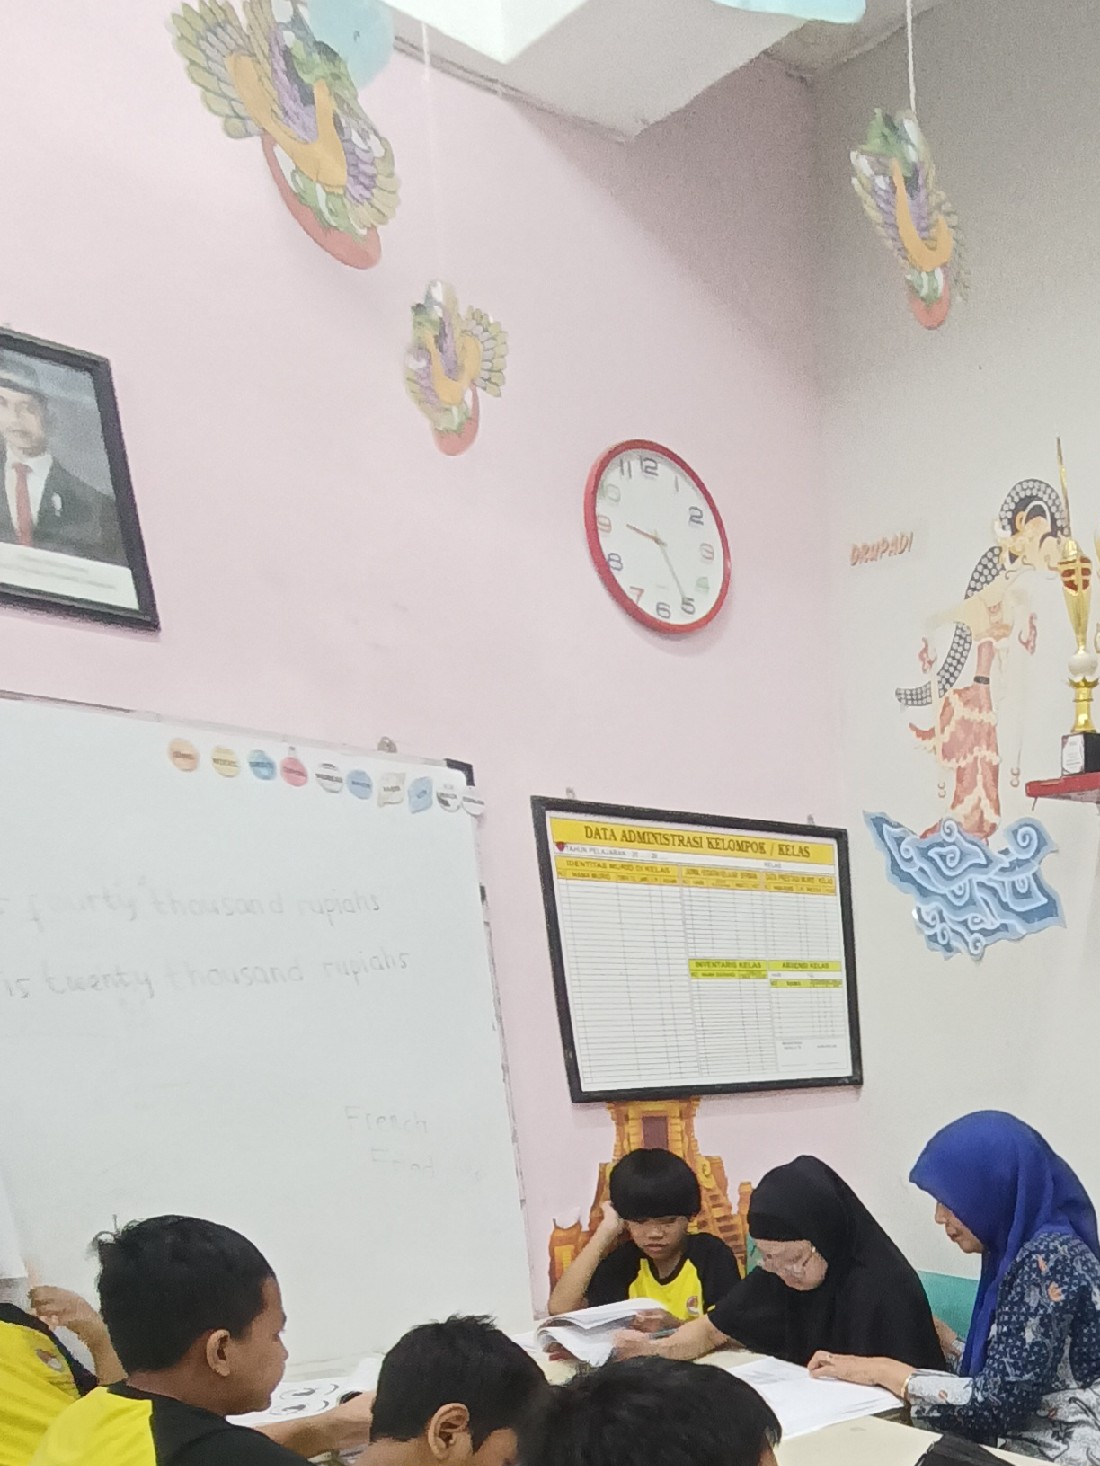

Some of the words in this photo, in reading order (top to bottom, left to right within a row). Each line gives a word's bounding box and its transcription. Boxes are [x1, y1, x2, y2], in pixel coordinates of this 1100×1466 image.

[619, 459, 632, 479] 11
[640, 455, 658, 477] 12
[688, 506, 704, 526] 2
[656, 601, 671, 619] 6
[584, 825, 617, 841] DATA
[621, 829, 703, 849] ADMINISTRASI
[706, 836, 767, 855] KELOMPOK
[778, 844, 810, 858] KELAS
